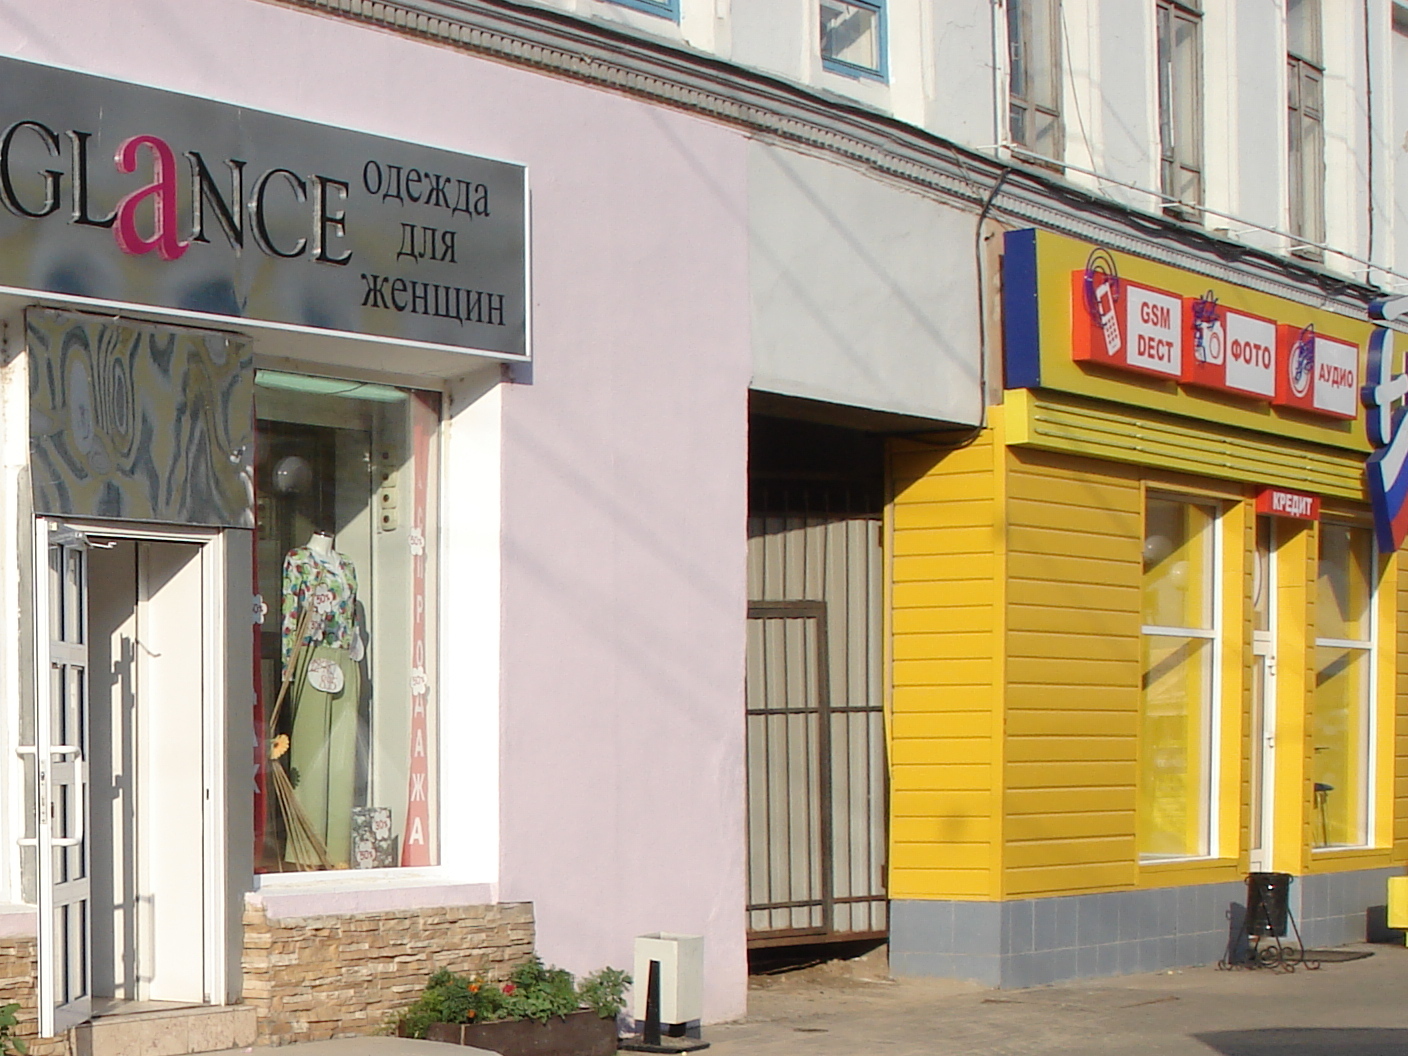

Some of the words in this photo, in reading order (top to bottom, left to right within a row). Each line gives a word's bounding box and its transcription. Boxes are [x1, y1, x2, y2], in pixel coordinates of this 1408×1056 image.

[362, 159, 490, 219] одежда
[396, 219, 457, 265] для
[360, 271, 505, 326] женщин
[1140, 302, 1171, 330] GSM
[1137, 334, 1174, 364] DECT
[1231, 341, 1272, 370] ФОТО
[1318, 362, 1354, 389] АУДИО
[1272, 492, 1313, 517] КРЕДИТ
